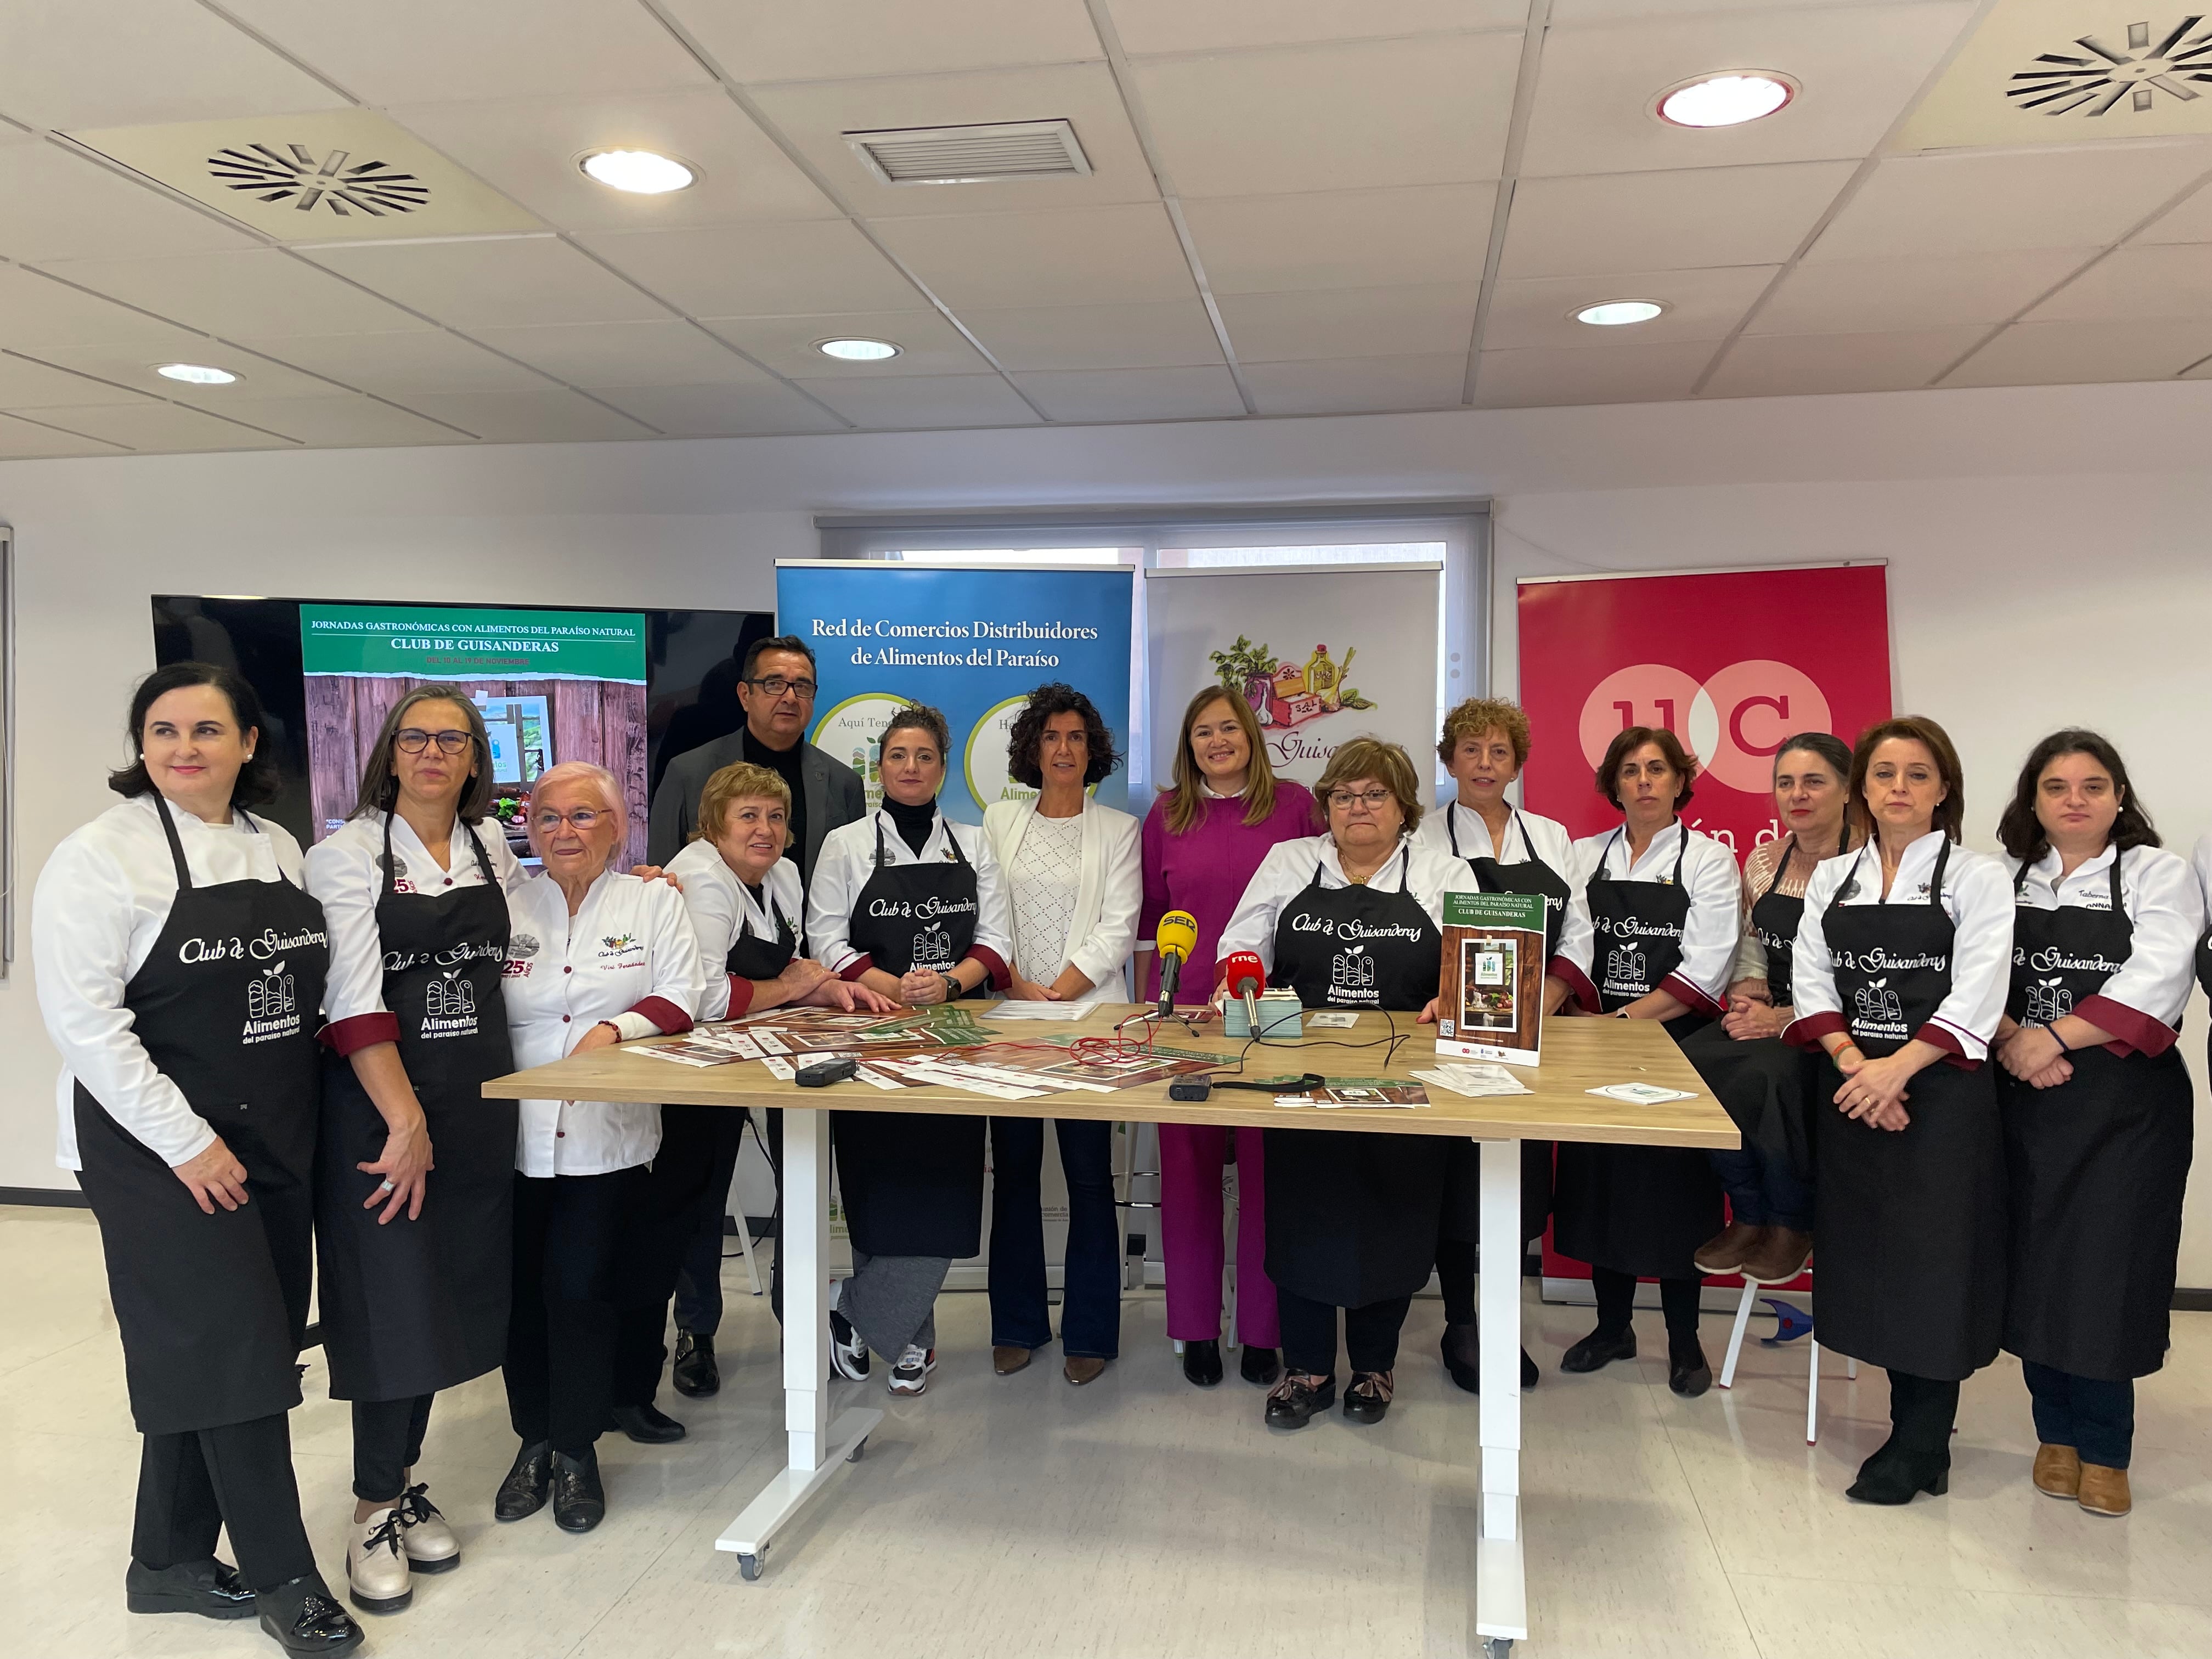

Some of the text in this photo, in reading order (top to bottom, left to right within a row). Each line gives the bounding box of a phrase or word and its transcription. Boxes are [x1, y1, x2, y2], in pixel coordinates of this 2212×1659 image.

[311, 620, 636, 636] JORNADAS GASTRONÓMICAS CON ALIMENTOS DEL PARAÍSO NATURAL
[811, 618, 1098, 640] Red de Comercios Distribuidores
[391, 638, 560, 652] CLUB DE GUISANDERAS
[851, 647, 1059, 667] de Alimentos del Paraíso
[838, 717, 864, 729] Aquí
[868, 898, 900, 917] Club
[901, 901, 912, 918] de
[1483, 910, 1526, 918] GUISANDERAS
[1163, 915, 1197, 933] SER
[1291, 912, 1423, 943] Club de Guisanderas
[1601, 917, 1611, 933] de
[1771, 933, 1783, 949] de
[179, 938, 226, 964] Club
[229, 937, 245, 959] de
[2013, 946, 2025, 966] de
[501, 960, 525, 974] 25
[1232, 954, 1259, 964] rne
[1844, 951, 1857, 969] de
[1327, 984, 1380, 998] Alimentos
[1602, 977, 1650, 992] Alimentos
[242, 1014, 300, 1036] Alimentos
[420, 1015, 478, 1031] Alimentos
[1851, 1017, 1908, 1033] Alimentos
[242, 1036, 254, 1045] del
[282, 1025, 300, 1037] natural
